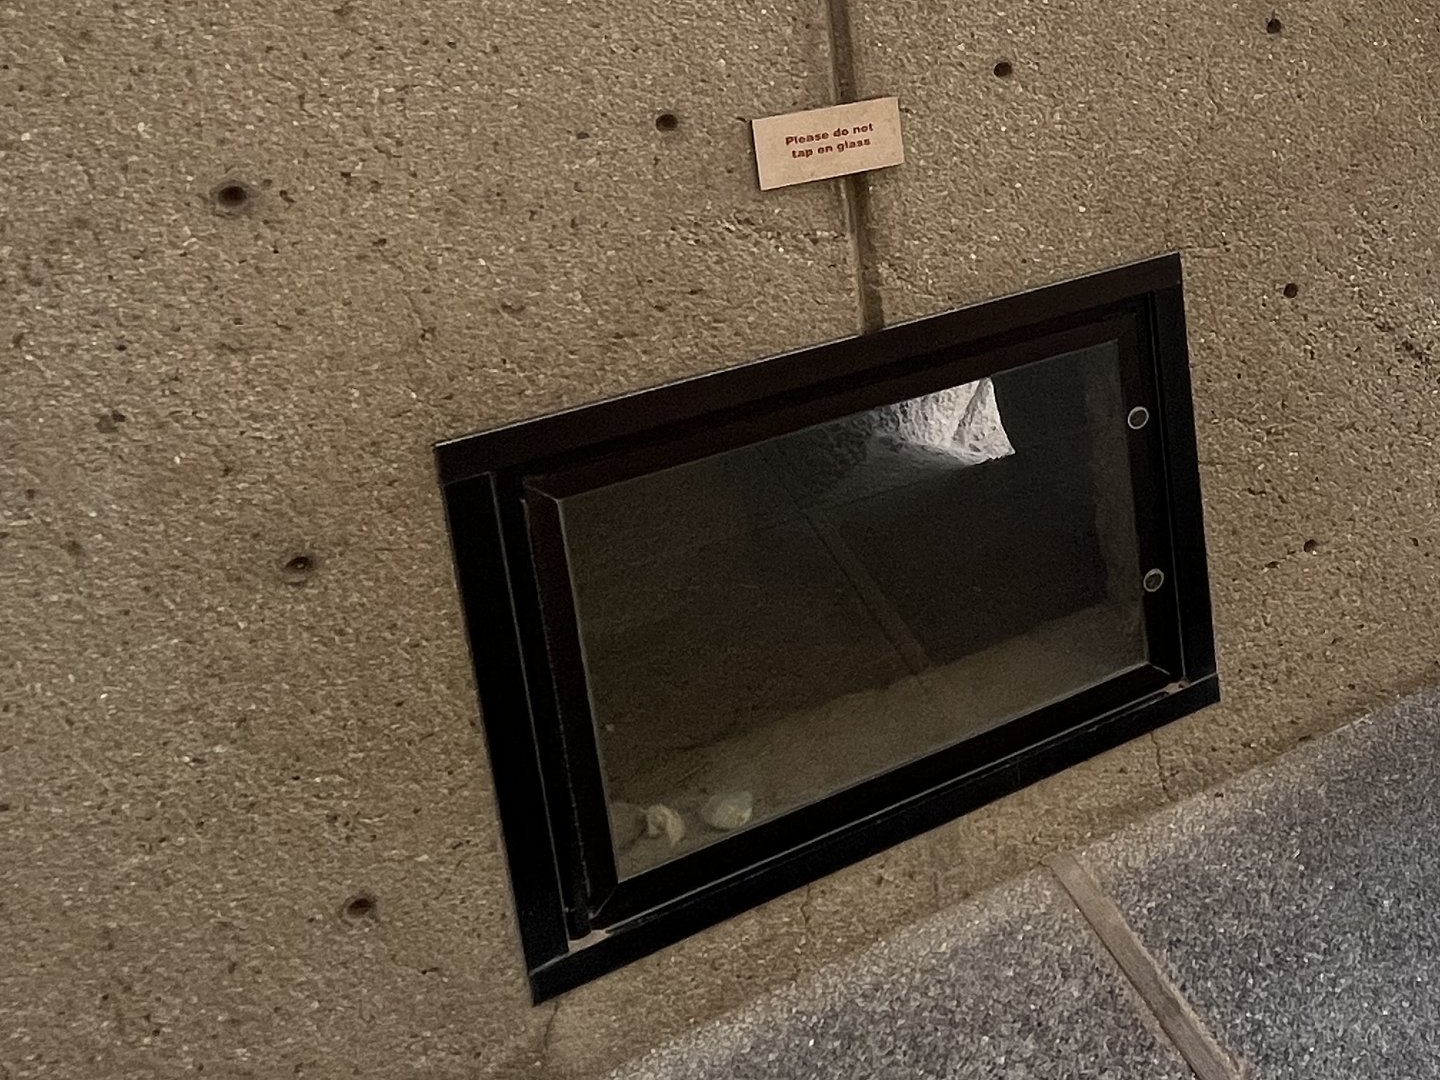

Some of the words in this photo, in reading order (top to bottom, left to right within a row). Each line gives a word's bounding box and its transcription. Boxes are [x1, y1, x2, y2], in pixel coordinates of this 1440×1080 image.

[785, 132, 829, 146] Please
[833, 127, 849, 138] do
[853, 123, 874, 135] not
[791, 149, 814, 159] tap
[817, 145, 834, 155] on
[837, 137, 871, 152] glass
